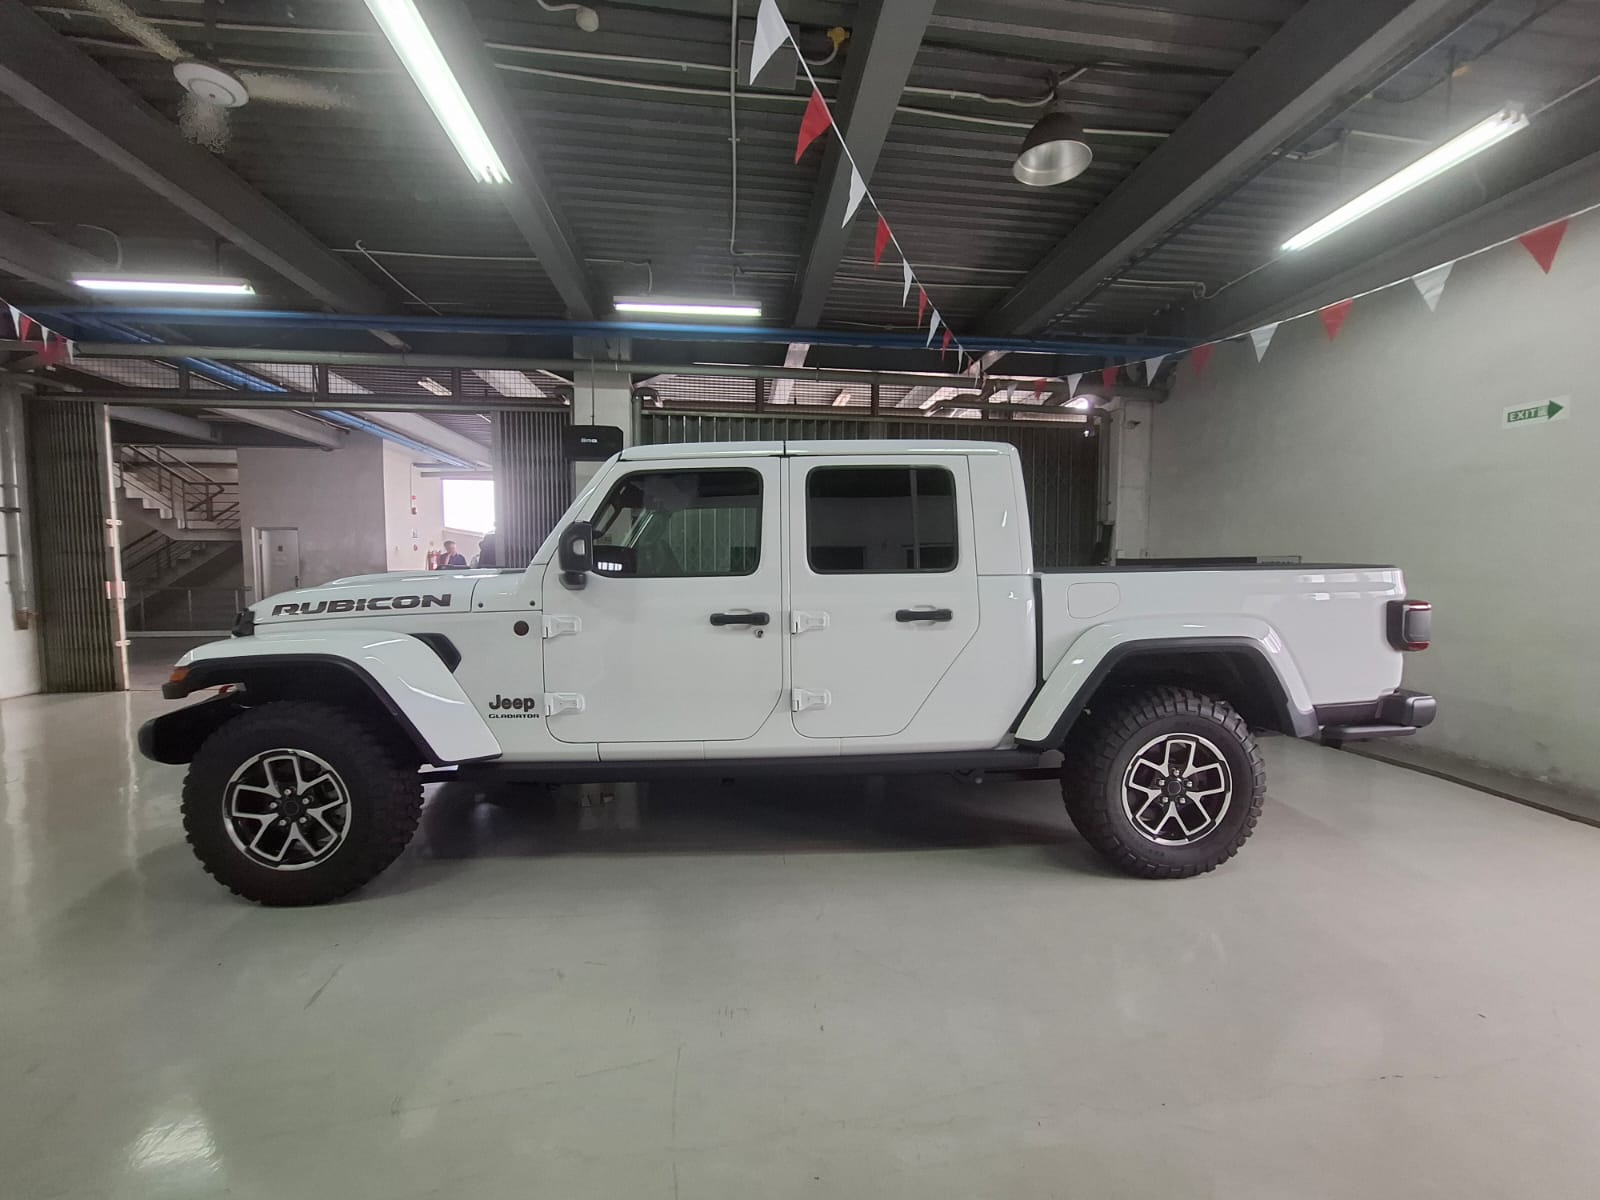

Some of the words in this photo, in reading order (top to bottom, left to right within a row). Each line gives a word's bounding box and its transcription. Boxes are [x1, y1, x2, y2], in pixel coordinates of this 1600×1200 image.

[1510, 409, 1538, 421] EXIT
[272, 594, 452, 616] RUBICON
[488, 694, 535, 713] Jeep
